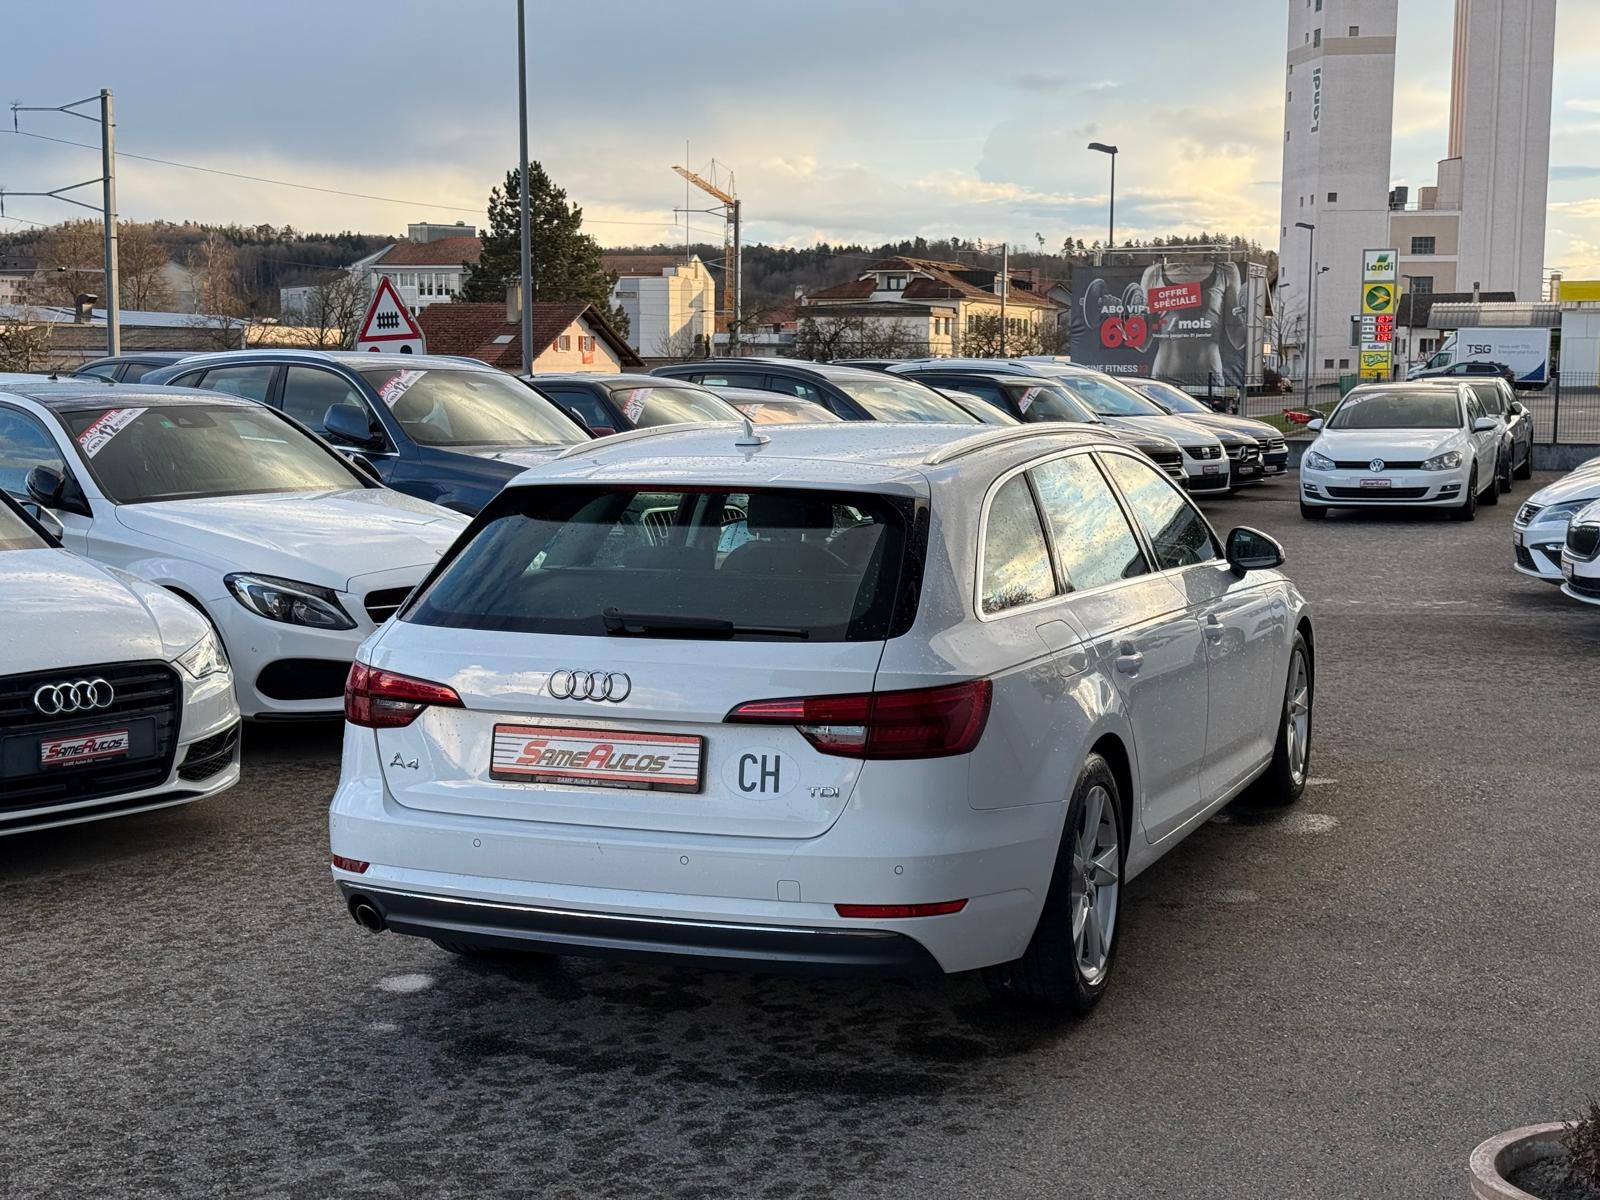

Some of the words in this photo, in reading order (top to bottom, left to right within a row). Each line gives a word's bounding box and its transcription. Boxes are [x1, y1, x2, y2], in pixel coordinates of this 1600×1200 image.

[1311, 68, 1321, 133] Landi
[1366, 262, 1394, 271] Landi
[1158, 287, 1189, 299] OFFRE
[1153, 295, 1198, 309] SPÉCIALE
[1101, 305, 1124, 314] ABO
[1178, 317, 1212, 329] mois
[1466, 344, 1492, 354] TSG
[1105, 364, 1138, 373] FITNESS
[99, 424, 120, 437] 12
[390, 752, 419, 770] A4
[738, 753, 781, 793] CH
[808, 787, 840, 798] TDI
